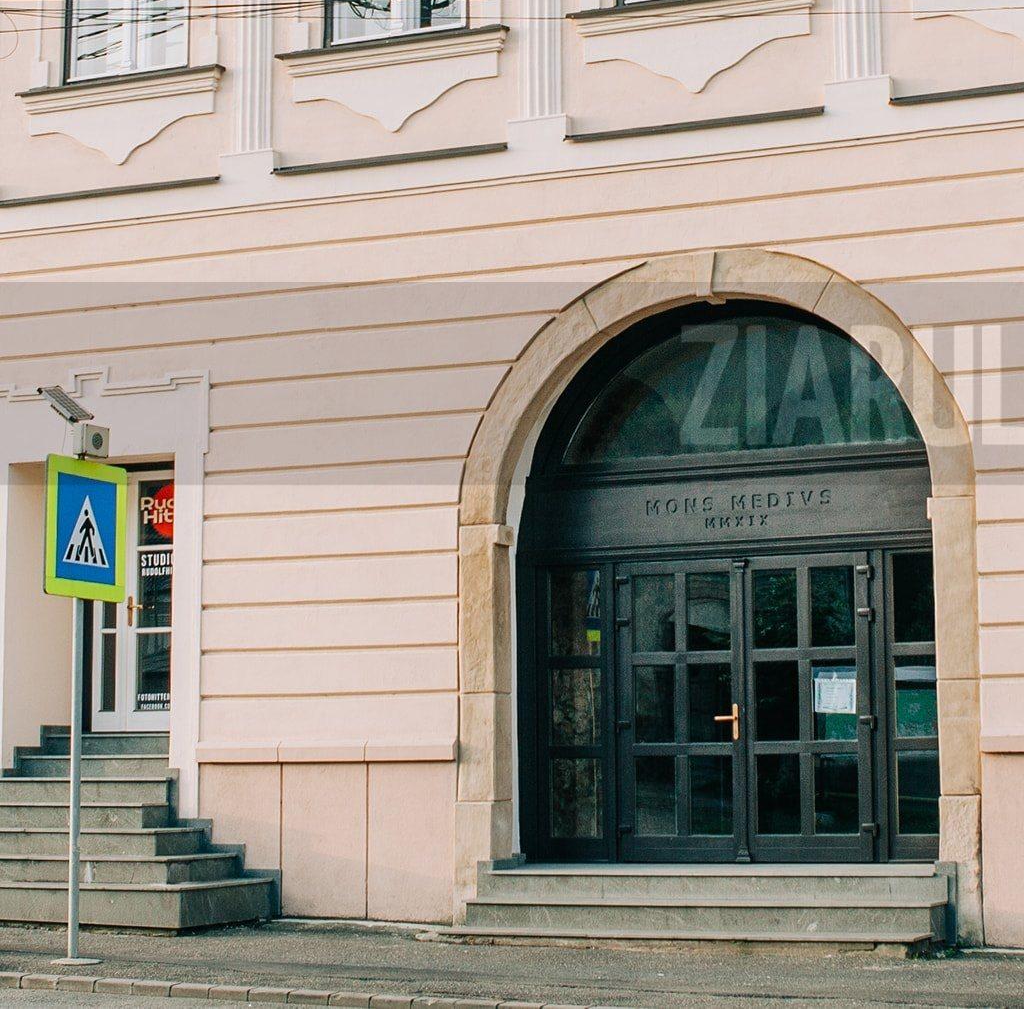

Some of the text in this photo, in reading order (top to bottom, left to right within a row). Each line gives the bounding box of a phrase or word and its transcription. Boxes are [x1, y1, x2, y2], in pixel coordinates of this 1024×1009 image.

[645, 489, 831, 516] MONS MEDIVS
[705, 515, 768, 529] MMXIX
